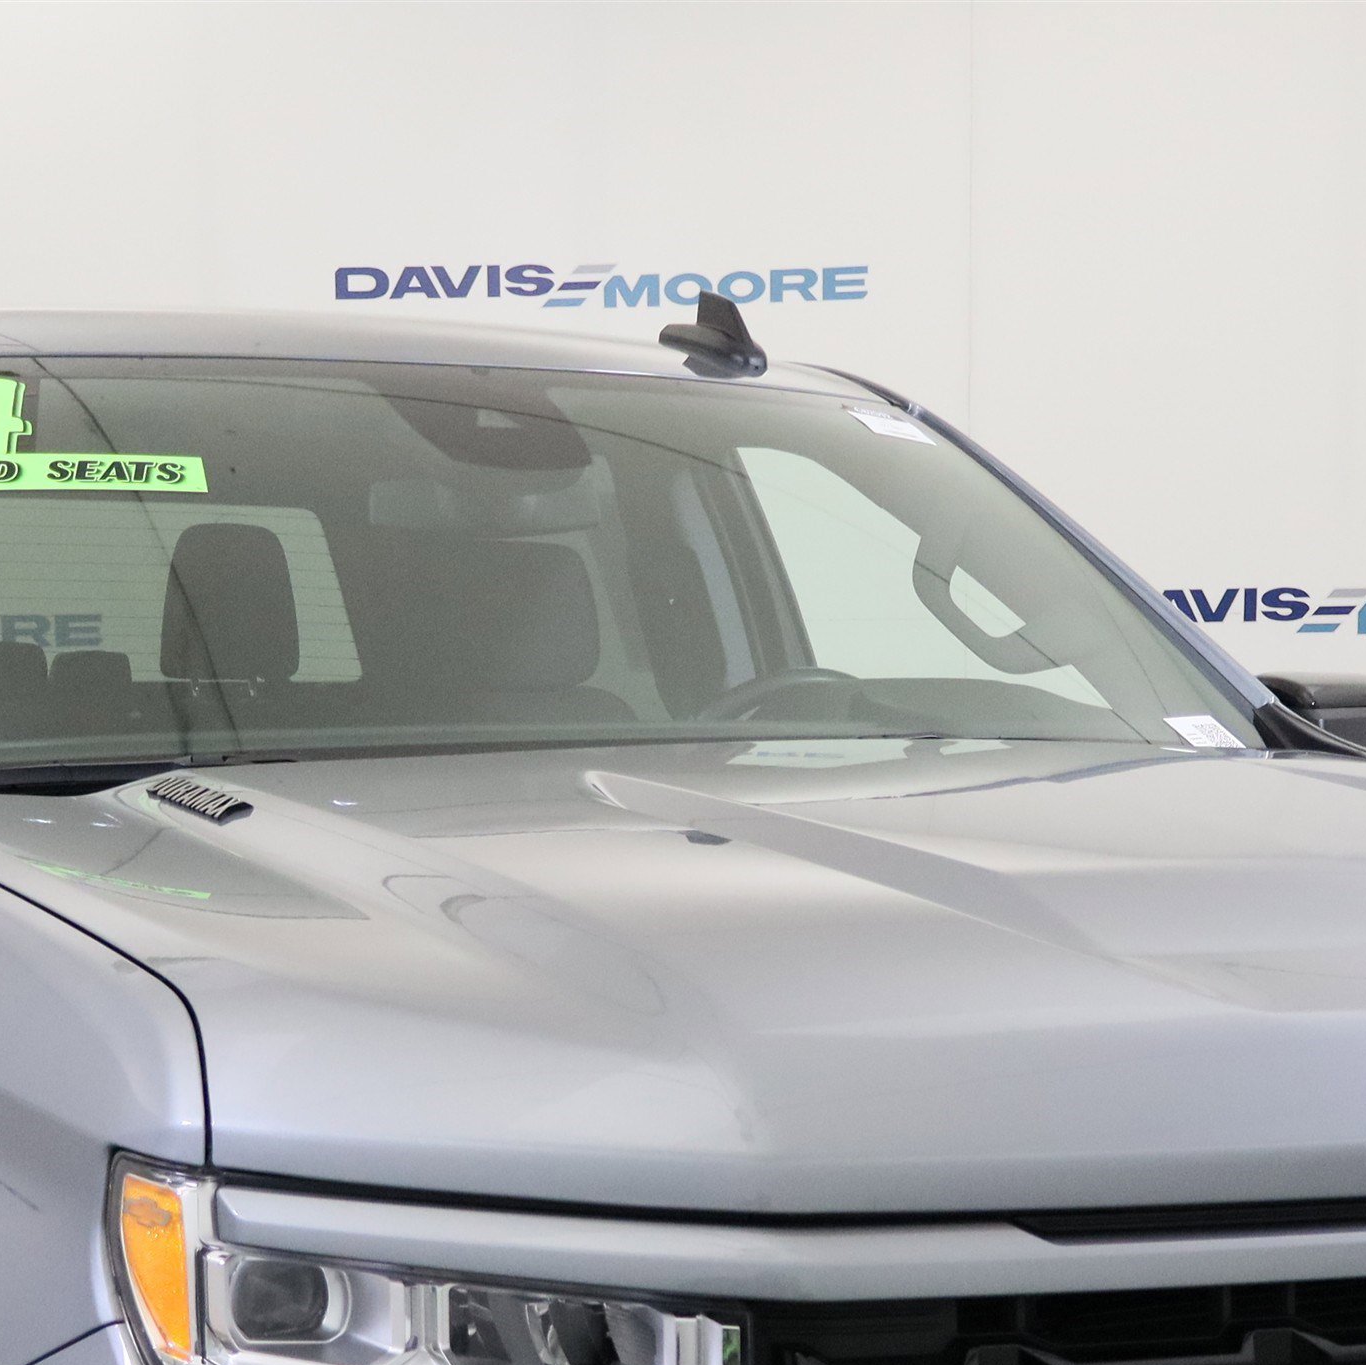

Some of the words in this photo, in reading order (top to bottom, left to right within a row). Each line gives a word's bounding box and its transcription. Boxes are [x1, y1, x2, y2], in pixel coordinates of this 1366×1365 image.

[335, 263, 555, 300] DAVIS
[603, 265, 869, 309] MOORE
[46, 459, 186, 484] SEATS
[1162, 587, 1310, 623] AVIS
